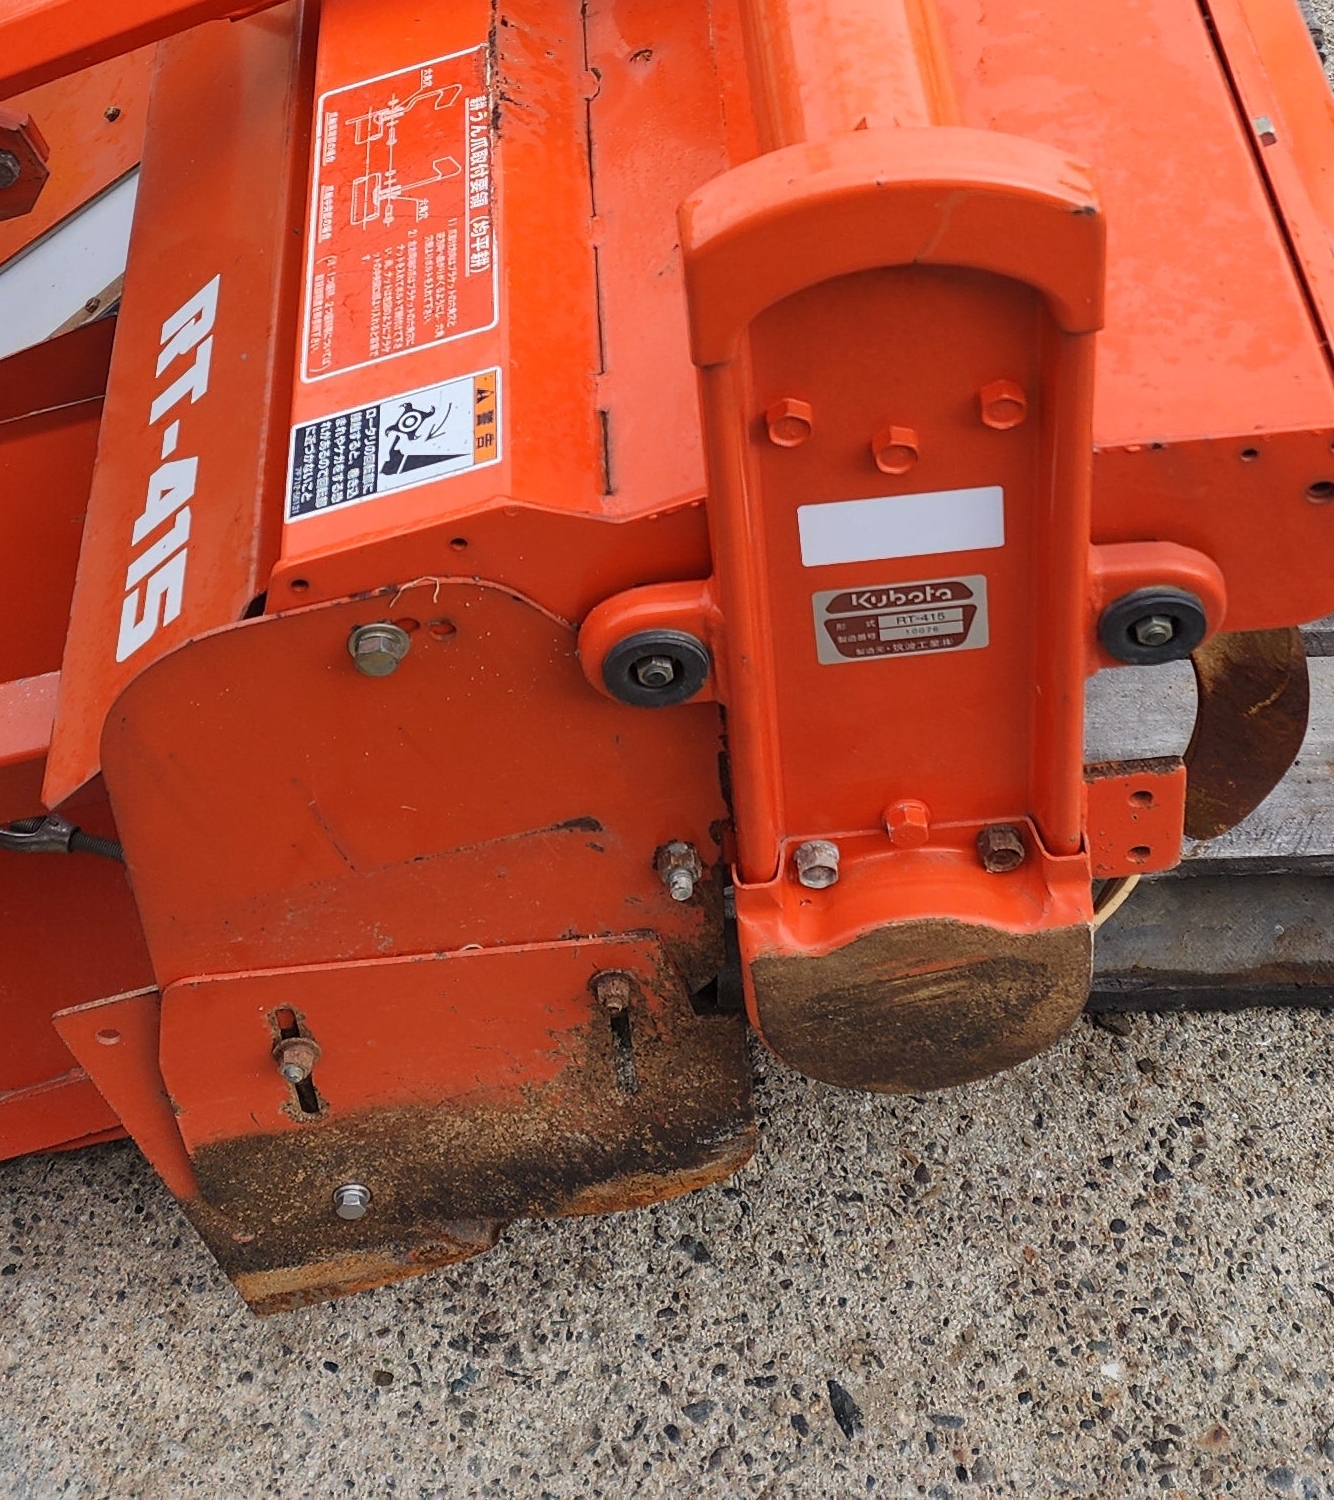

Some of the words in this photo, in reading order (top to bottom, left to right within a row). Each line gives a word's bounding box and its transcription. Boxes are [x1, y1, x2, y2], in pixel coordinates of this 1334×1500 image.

[476, 409, 494, 450] 警告
[117, 273, 221, 663] RT-415
[851, 585, 952, 609] Kubota
[896, 611, 946, 625] RT-415
